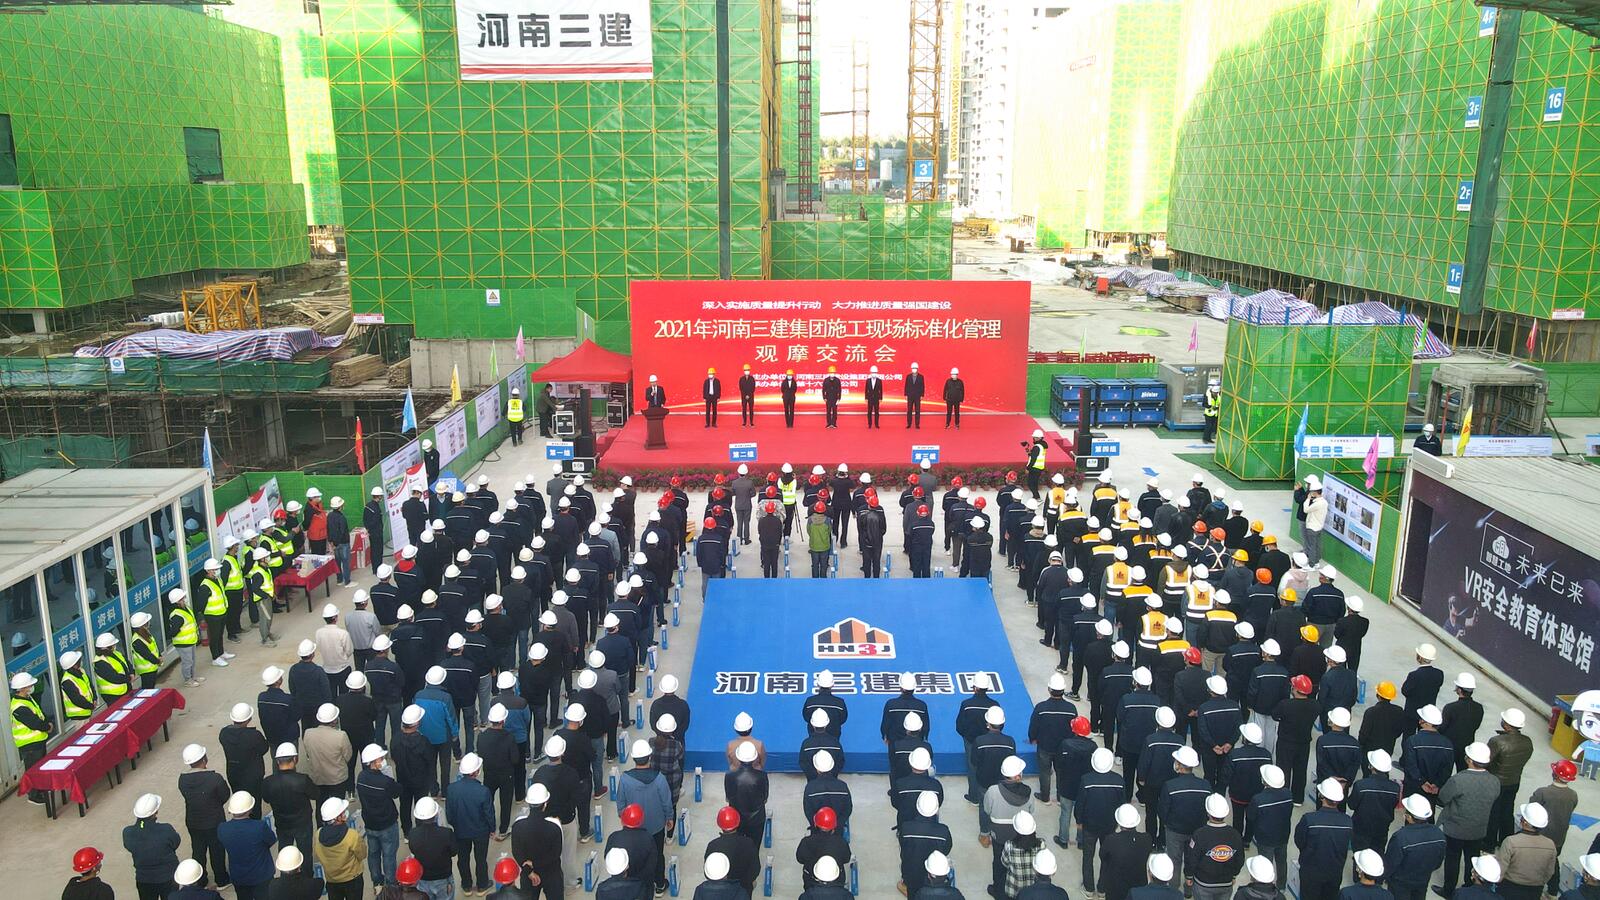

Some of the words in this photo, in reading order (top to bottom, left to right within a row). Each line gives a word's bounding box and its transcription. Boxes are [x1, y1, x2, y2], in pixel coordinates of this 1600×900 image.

[1483, 9, 1495, 25] 4F
[476, 12, 633, 48] 河南三建
[1467, 101, 1480, 116] 3F
[1548, 92, 1562, 109] 16
[1459, 185, 1471, 200] 2F
[1450, 268, 1461, 283] 1F
[702, 301, 822, 310] 深入实施质量提升行动
[832, 301, 952, 310] 大力推进质量强国建设
[653, 318, 1002, 340] 2021年河南三建集团施工现场标准化管理
[754, 343, 897, 363] 观摩交流会
[159, 569, 176, 587] 封样
[1515, 554, 1584, 605] 未来已来
[134, 586, 151, 606] 封样
[97, 606, 116, 629] 资料
[1465, 565, 1595, 674] VR安全教育体验馆
[58, 627, 80, 651] 资料
[817, 643, 891, 657] HN3J
